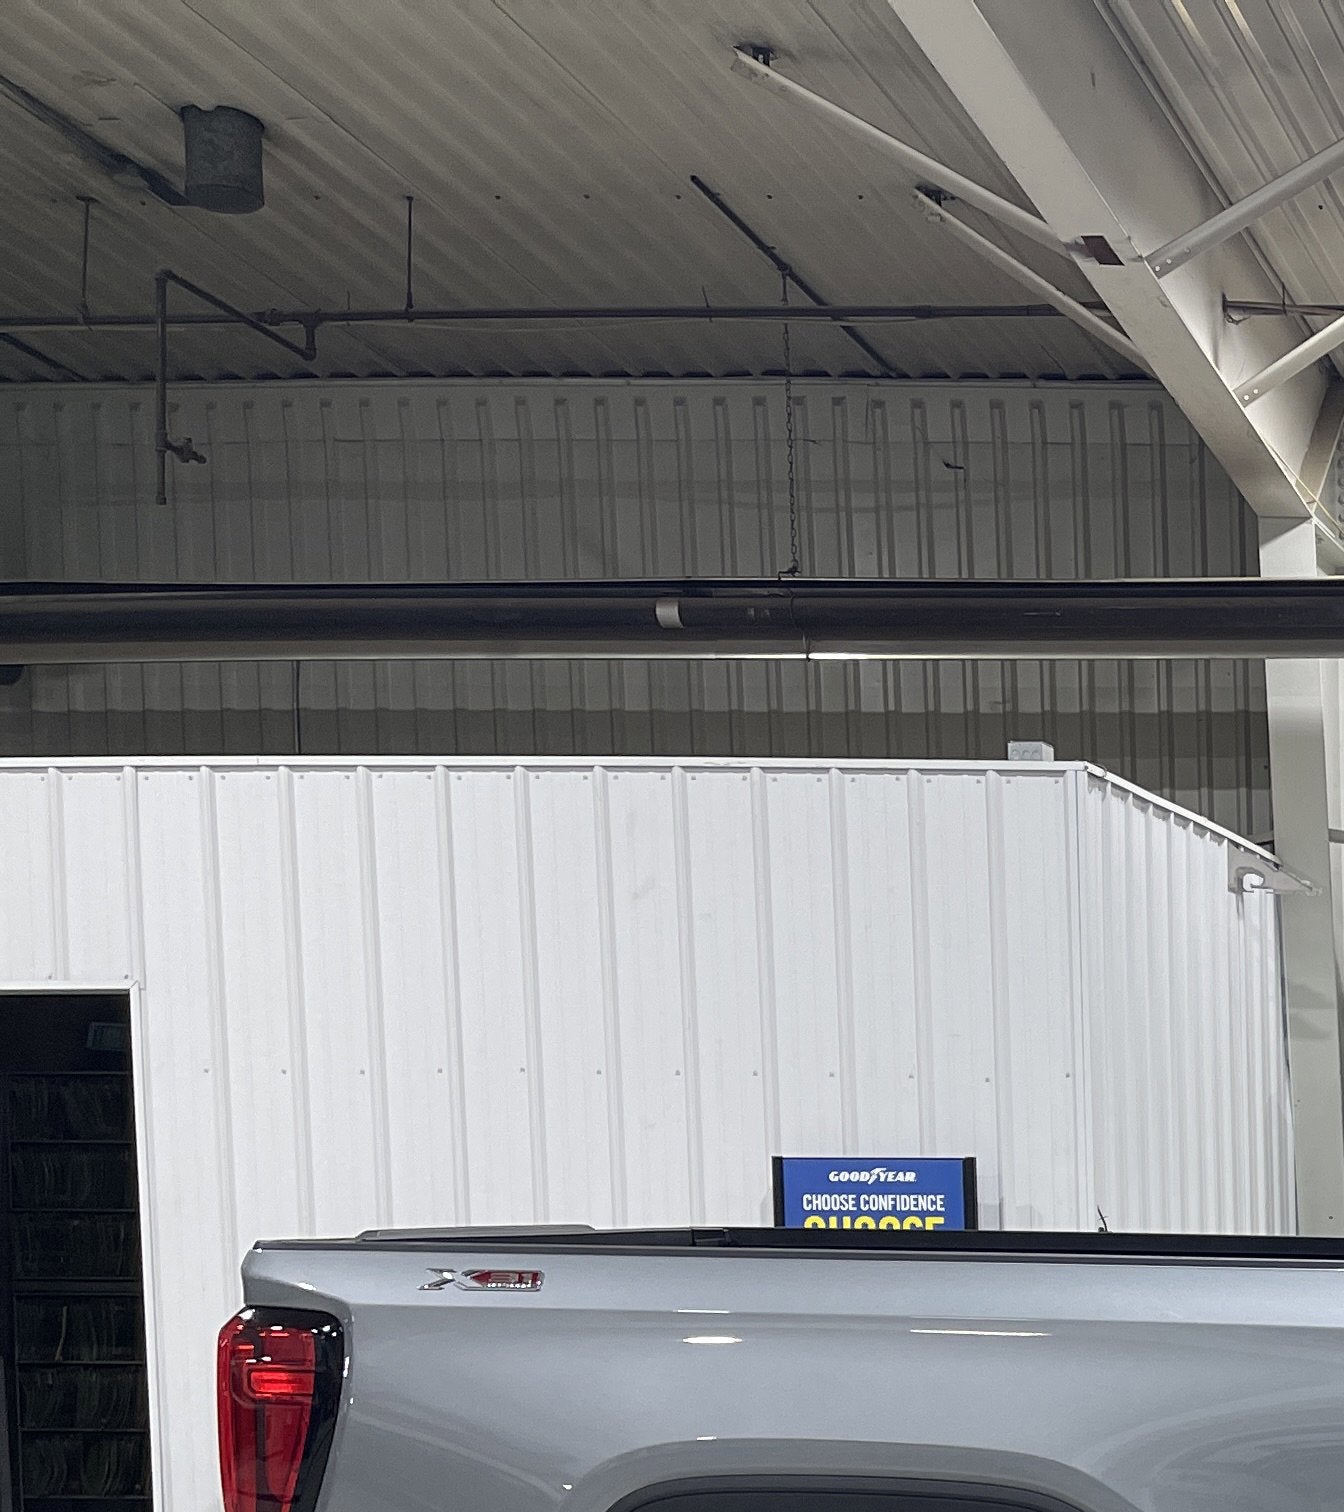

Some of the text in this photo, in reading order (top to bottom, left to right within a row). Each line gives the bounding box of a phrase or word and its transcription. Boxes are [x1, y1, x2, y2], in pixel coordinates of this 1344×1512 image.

[828, 1167, 917, 1184] GOODYEAR
[802, 1194, 945, 1212] CHOOSE CONFIDENCE
